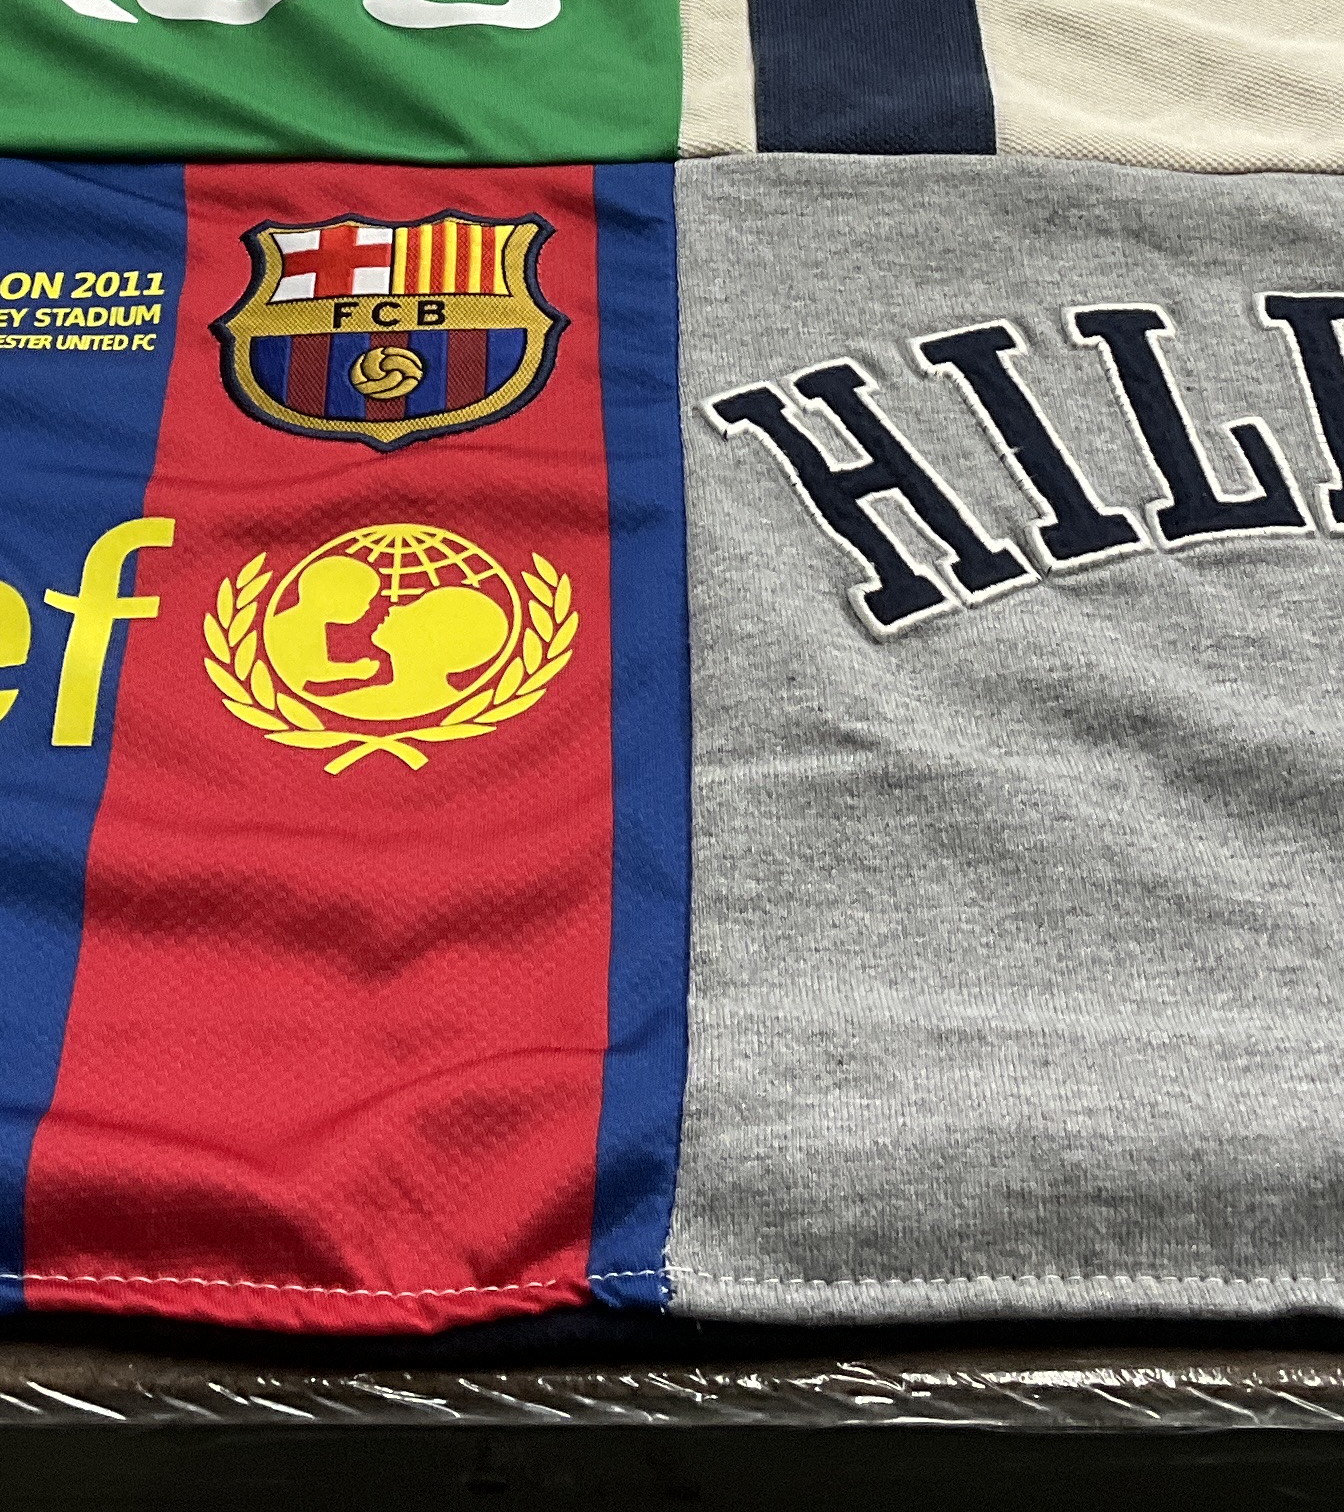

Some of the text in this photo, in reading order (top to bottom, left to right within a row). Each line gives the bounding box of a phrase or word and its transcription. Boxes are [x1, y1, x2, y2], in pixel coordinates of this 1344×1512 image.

[69, 270, 166, 300] 2011
[32, 303, 161, 329] STADIUM
[55, 334, 130, 352] UNITED
[131, 333, 158, 352] FC
